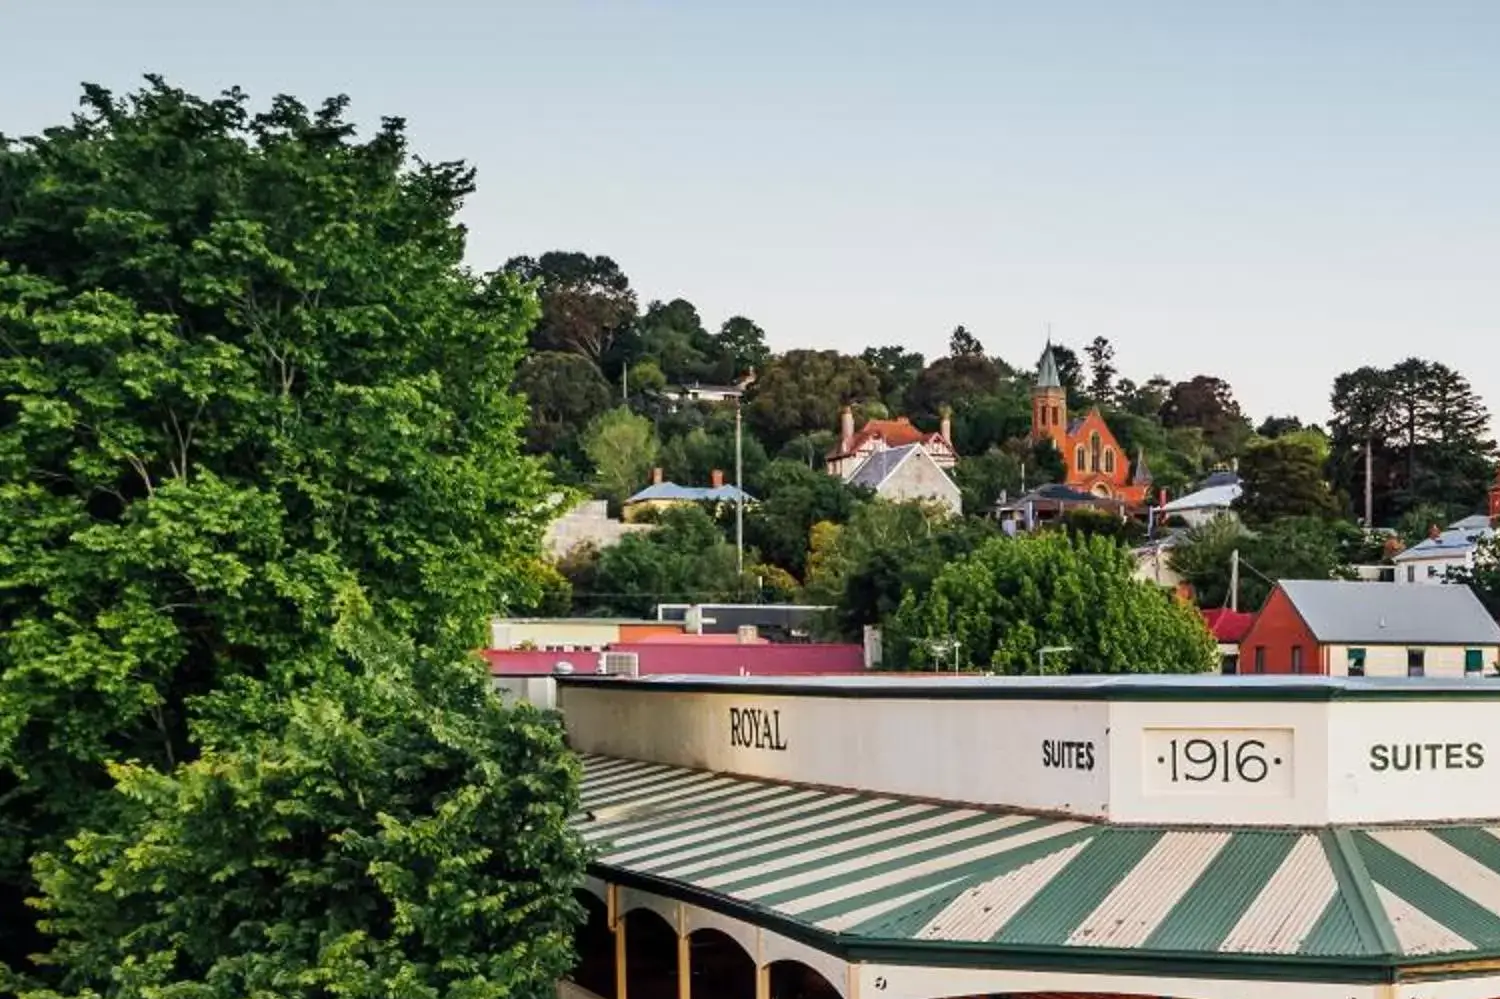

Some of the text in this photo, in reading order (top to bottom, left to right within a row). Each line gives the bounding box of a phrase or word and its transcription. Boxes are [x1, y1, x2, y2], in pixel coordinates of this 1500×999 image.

[729, 708, 787, 751] ROYAL
[1042, 739, 1095, 771] SUITES
[1369, 742, 1485, 772] SUITES
